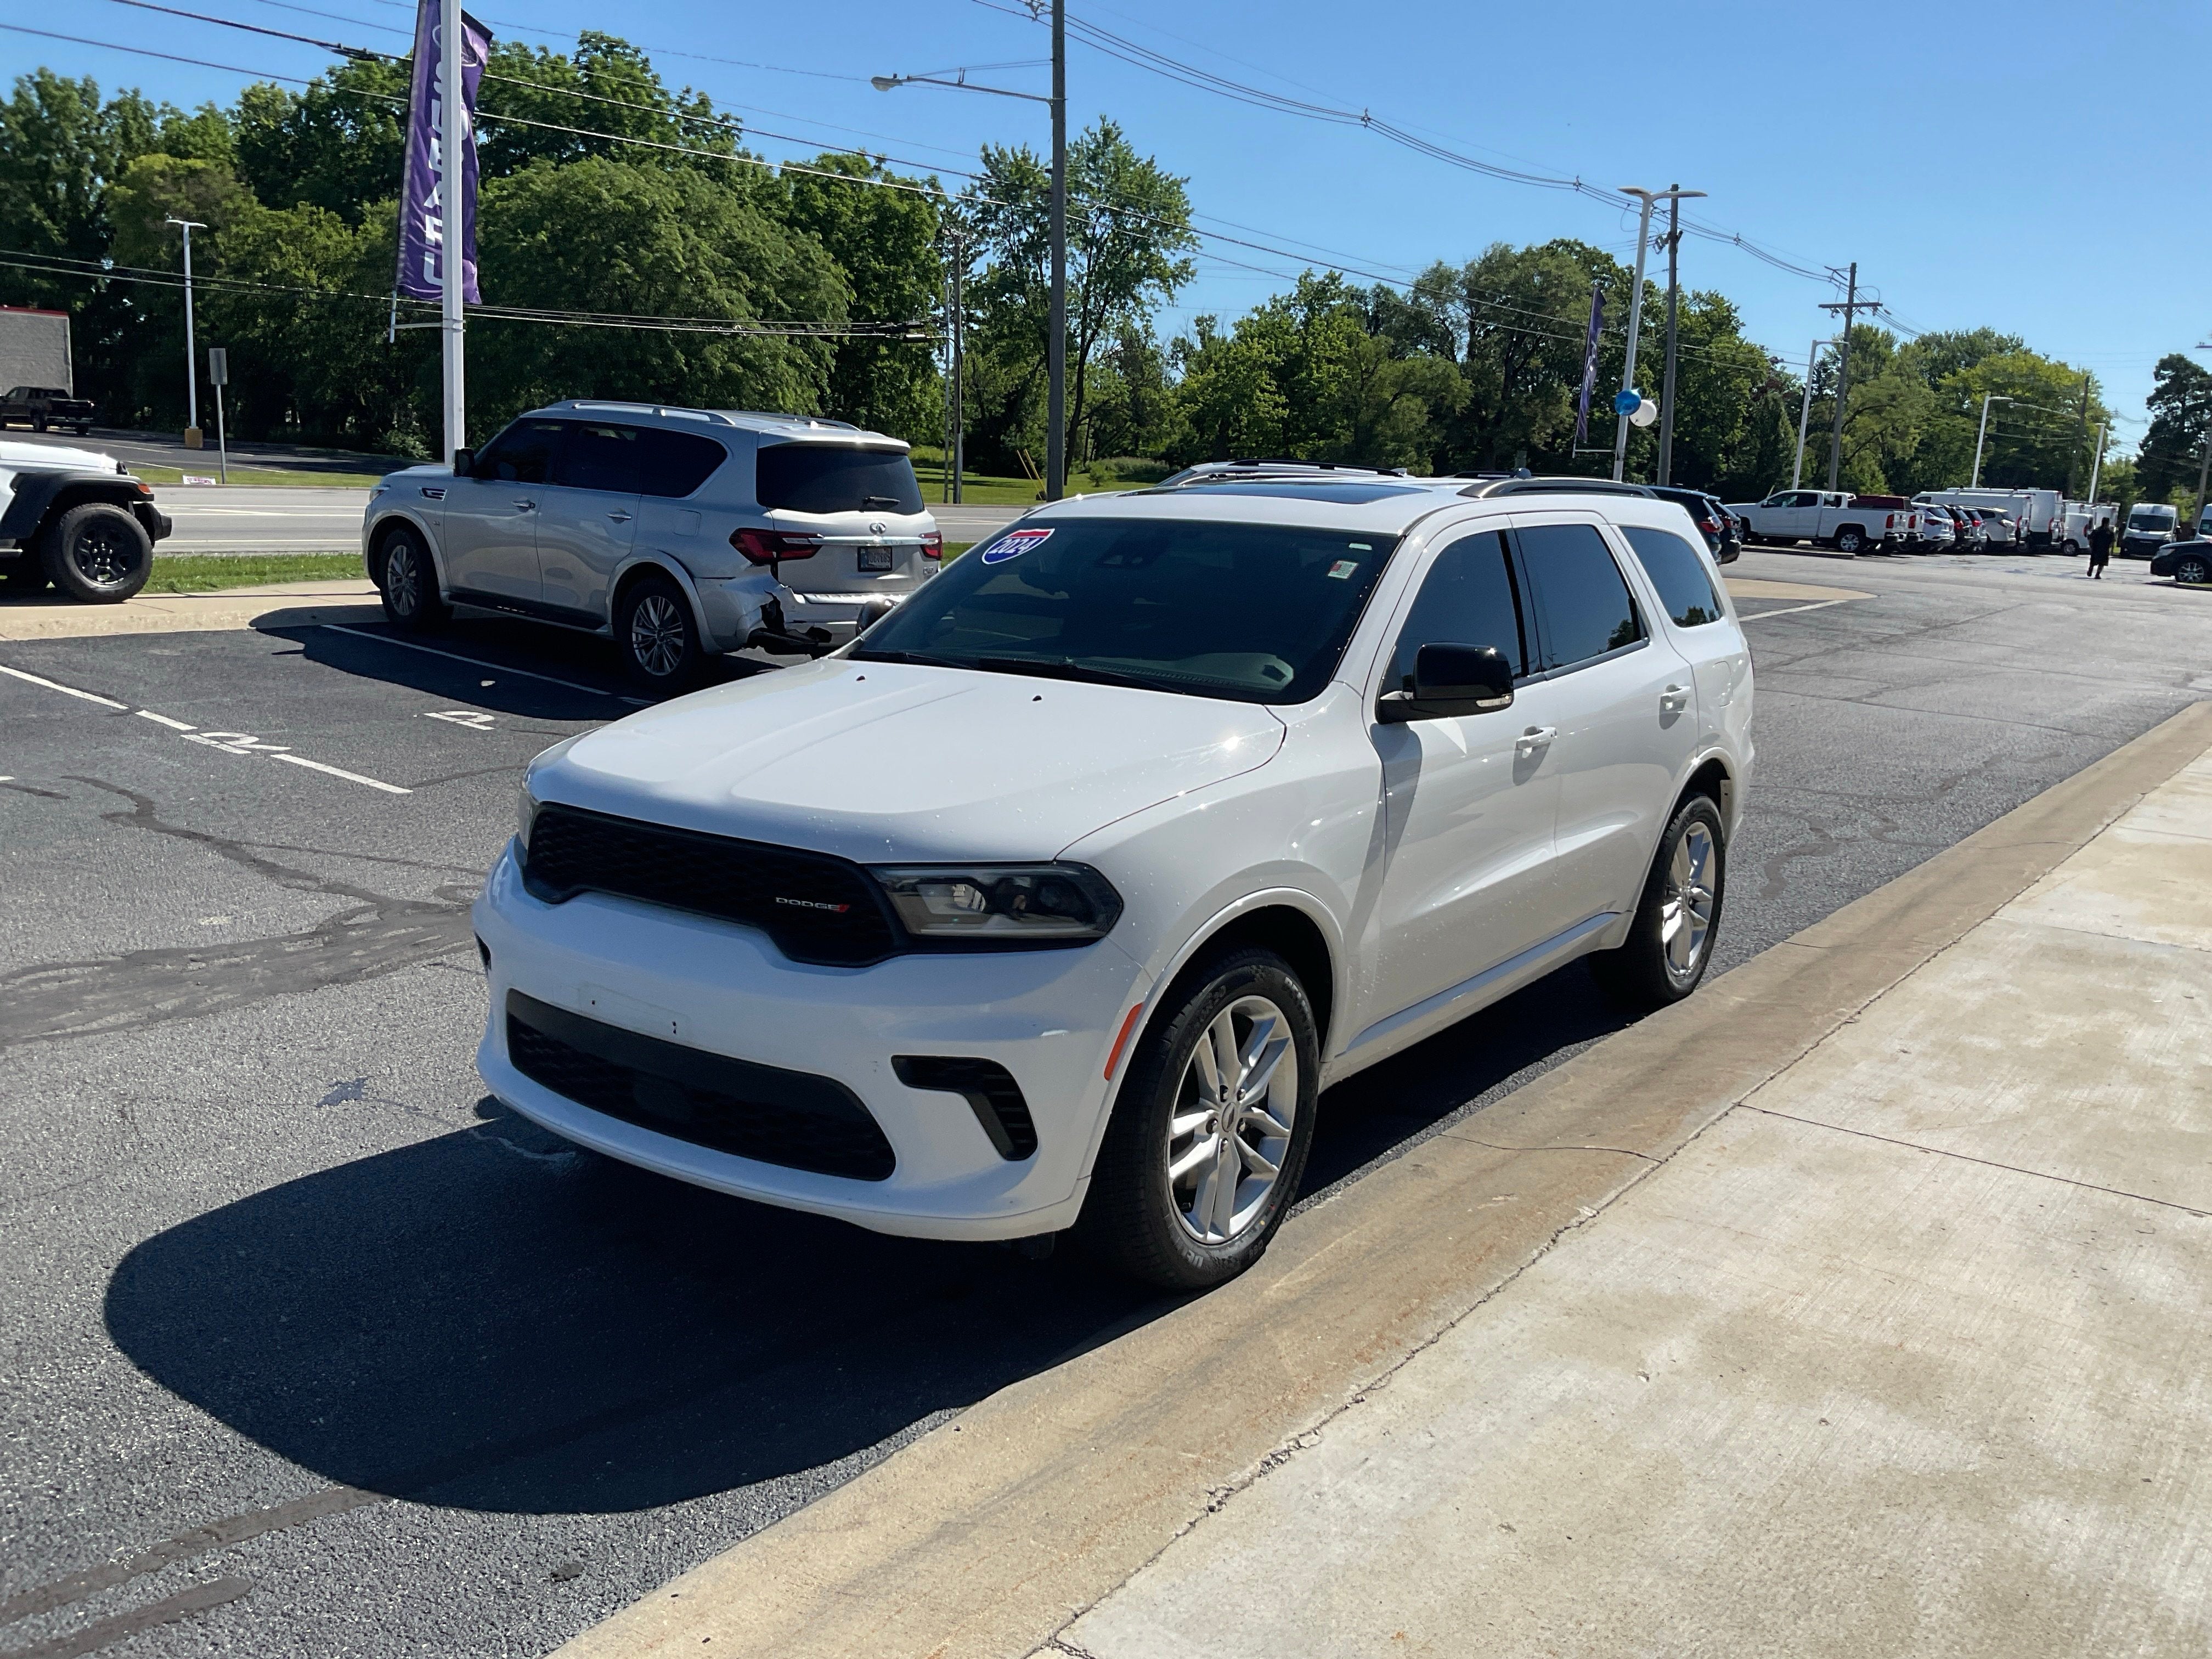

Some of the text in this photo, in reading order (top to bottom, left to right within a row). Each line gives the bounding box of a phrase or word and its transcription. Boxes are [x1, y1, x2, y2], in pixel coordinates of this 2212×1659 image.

[988, 538, 1040, 554] 2024
[180, 731, 291, 754] R
[776, 897, 840, 911] DODGE
